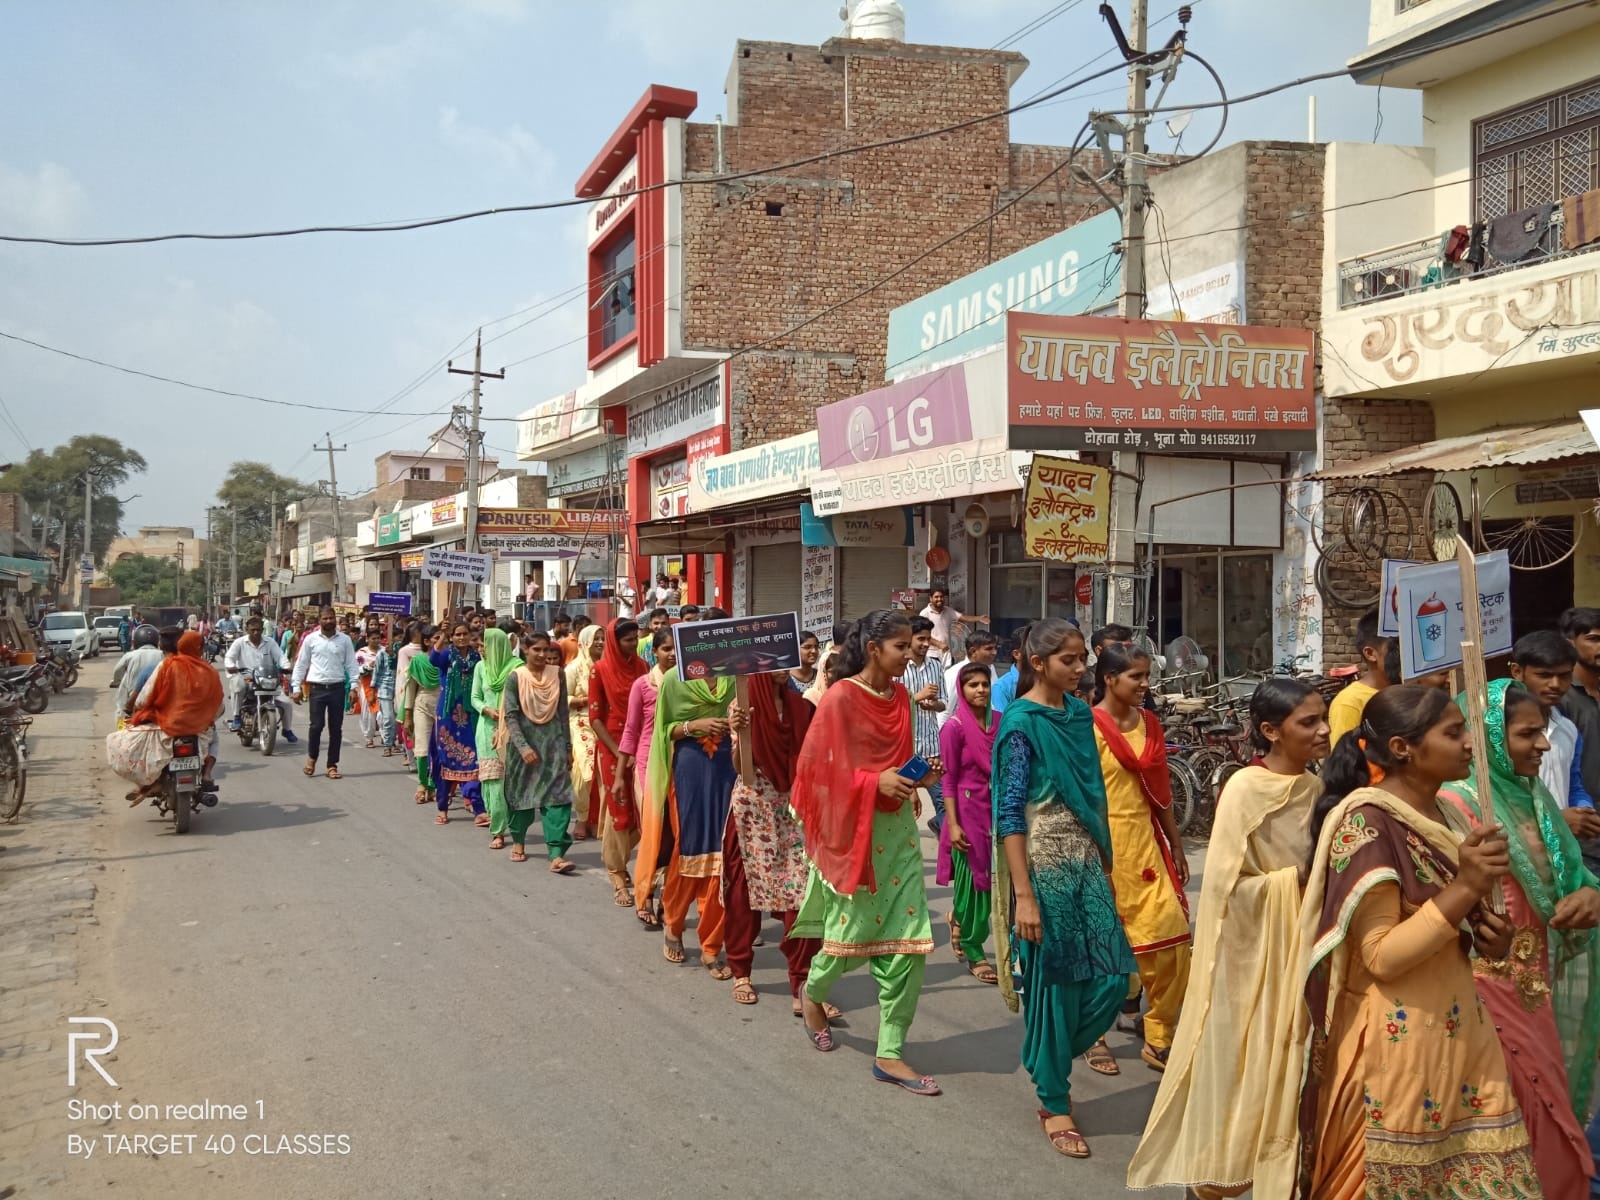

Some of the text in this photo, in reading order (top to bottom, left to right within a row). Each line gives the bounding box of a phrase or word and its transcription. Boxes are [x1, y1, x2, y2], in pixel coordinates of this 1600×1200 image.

[921, 250, 1079, 350] SAMSUNG
[1019, 333, 1121, 386] यादव
[1019, 400, 1042, 419] हमारे
[1068, 406, 1080, 418] पर
[887, 398, 934, 452] LG
[1085, 427, 1119, 446] टोहाना
[1154, 432, 1175, 449] भूना
[1201, 433, 1256, 445] 9416592117
[842, 475, 886, 501] यादव
[1038, 465, 1097, 493] यादव
[485, 512, 551, 526] PARVESH
[844, 520, 870, 529] TATA
[698, 630, 710, 639] हम
[736, 624, 750, 633] एक
[772, 632, 793, 643] हमारा
